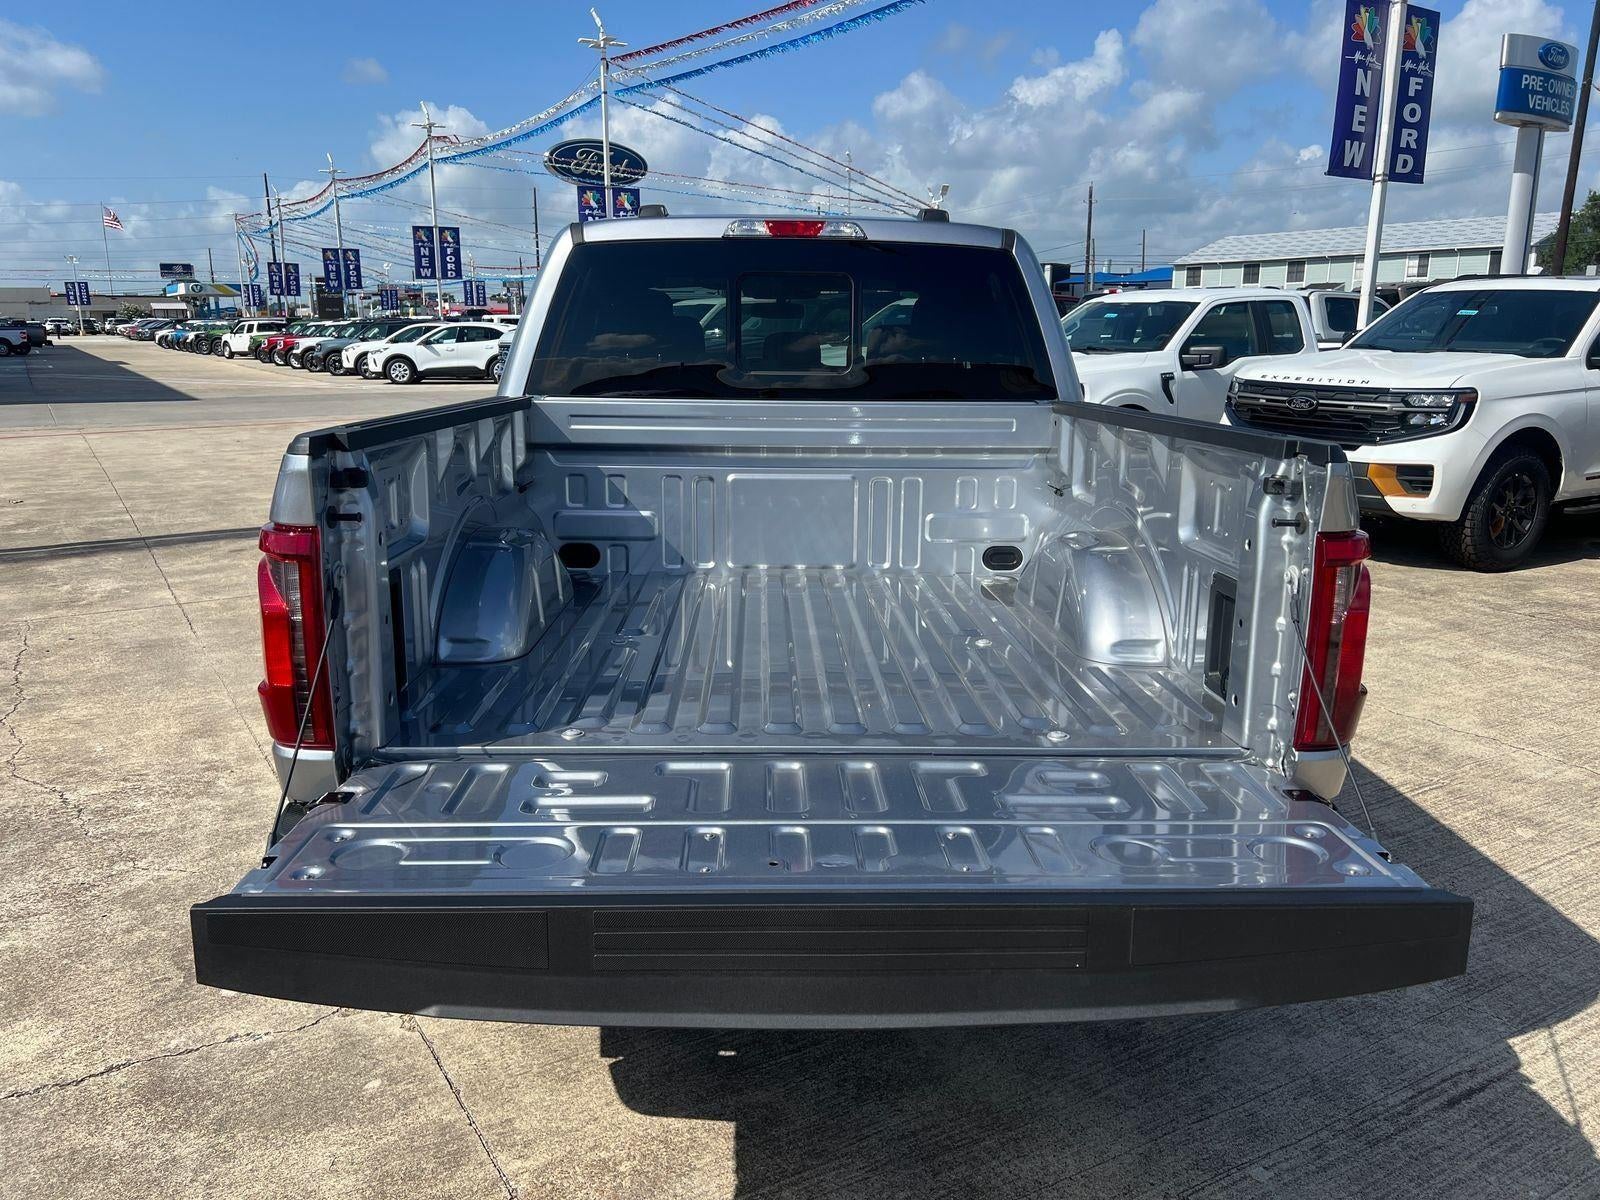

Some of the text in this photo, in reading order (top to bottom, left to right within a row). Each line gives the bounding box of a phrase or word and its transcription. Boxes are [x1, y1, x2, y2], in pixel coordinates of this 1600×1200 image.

[1548, 46, 1566, 64] Ford
[1528, 94, 1570, 116] VEHICLES
[1344, 68, 1371, 168] NEW
[1395, 77, 1424, 174] FORD
[420, 247, 432, 277] NEW
[446, 248, 456, 278] FORD
[272, 276, 281, 295] NEW
[328, 264, 339, 288] NEW
[349, 265, 358, 288] FORD
[1260, 374, 1370, 385] EXPEDITION
[1290, 399, 1310, 409] Ford
